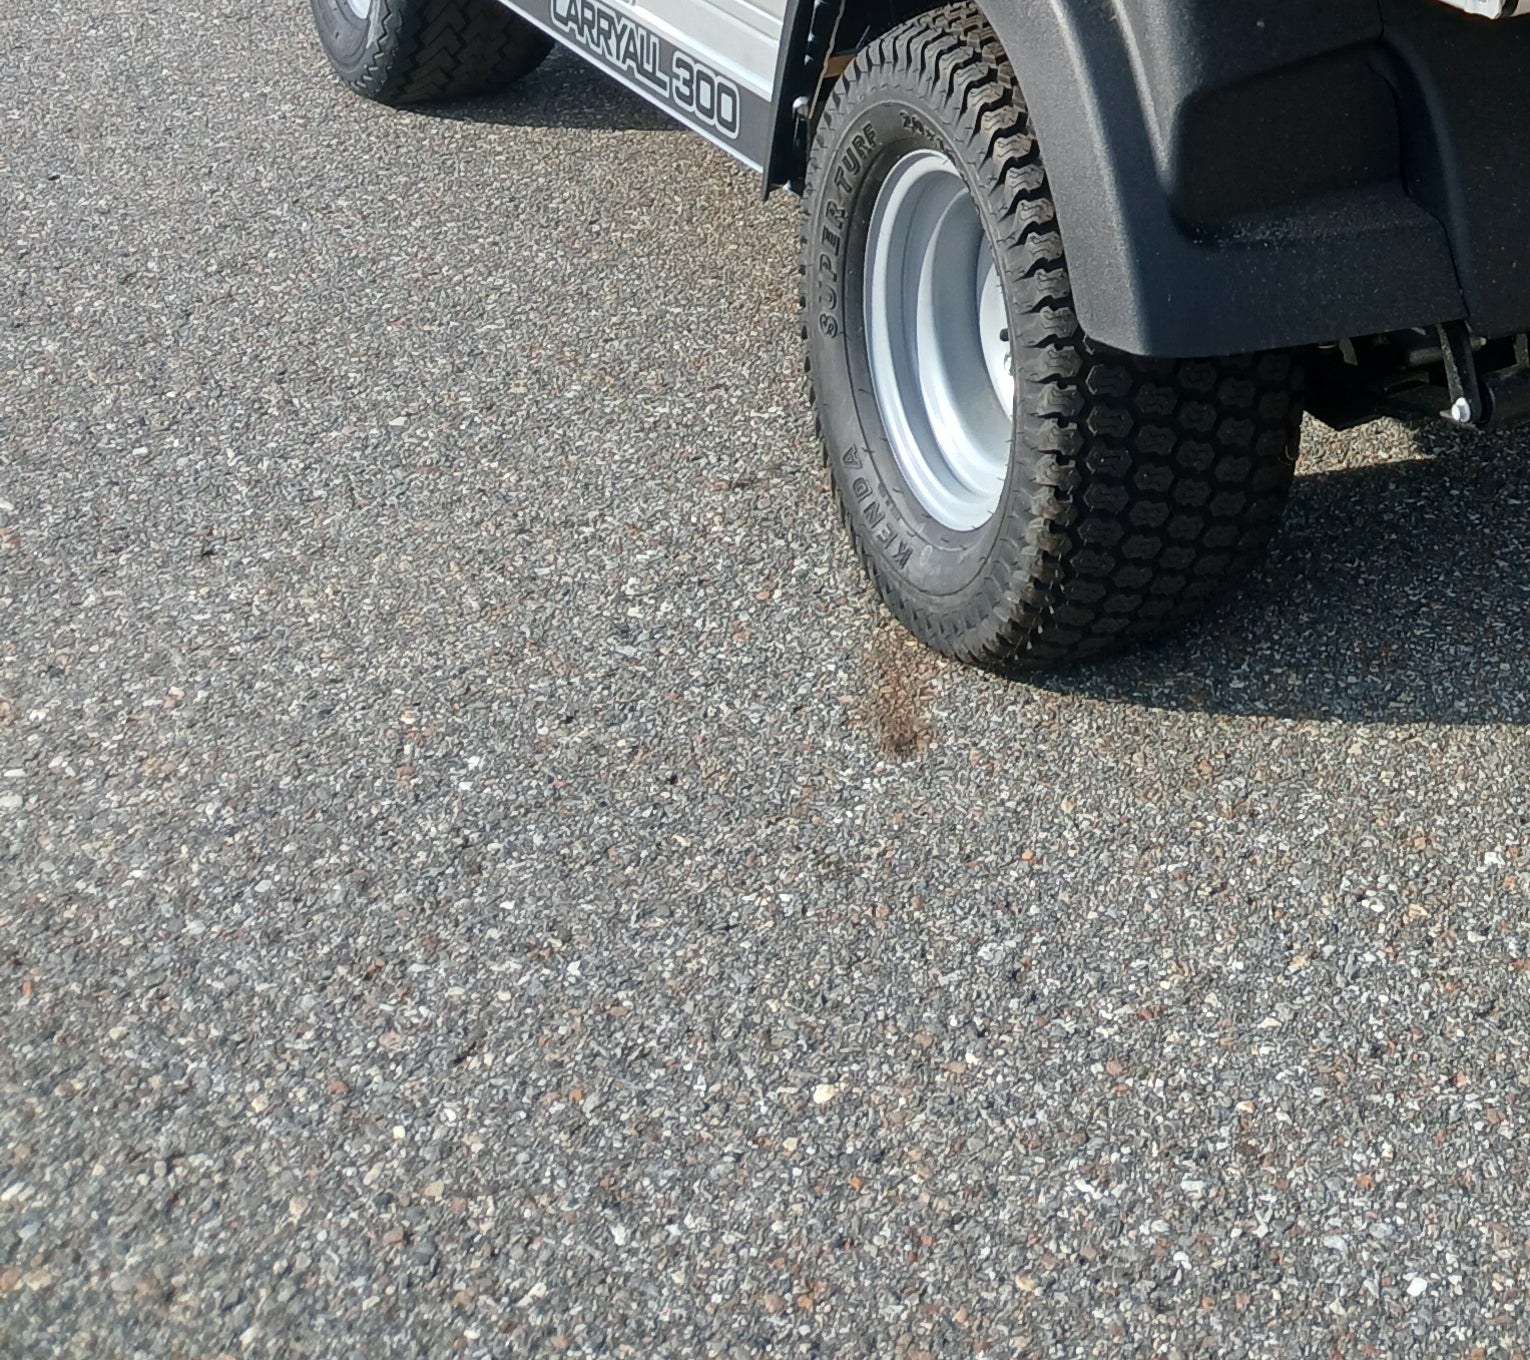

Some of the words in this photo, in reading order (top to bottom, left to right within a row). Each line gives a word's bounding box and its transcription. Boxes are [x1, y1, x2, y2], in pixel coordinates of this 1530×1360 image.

[672, 50, 740, 140] 300
[819, 200, 849, 338] SUPER
[834, 123, 877, 194] TURF
[842, 444, 914, 570] KENDA
